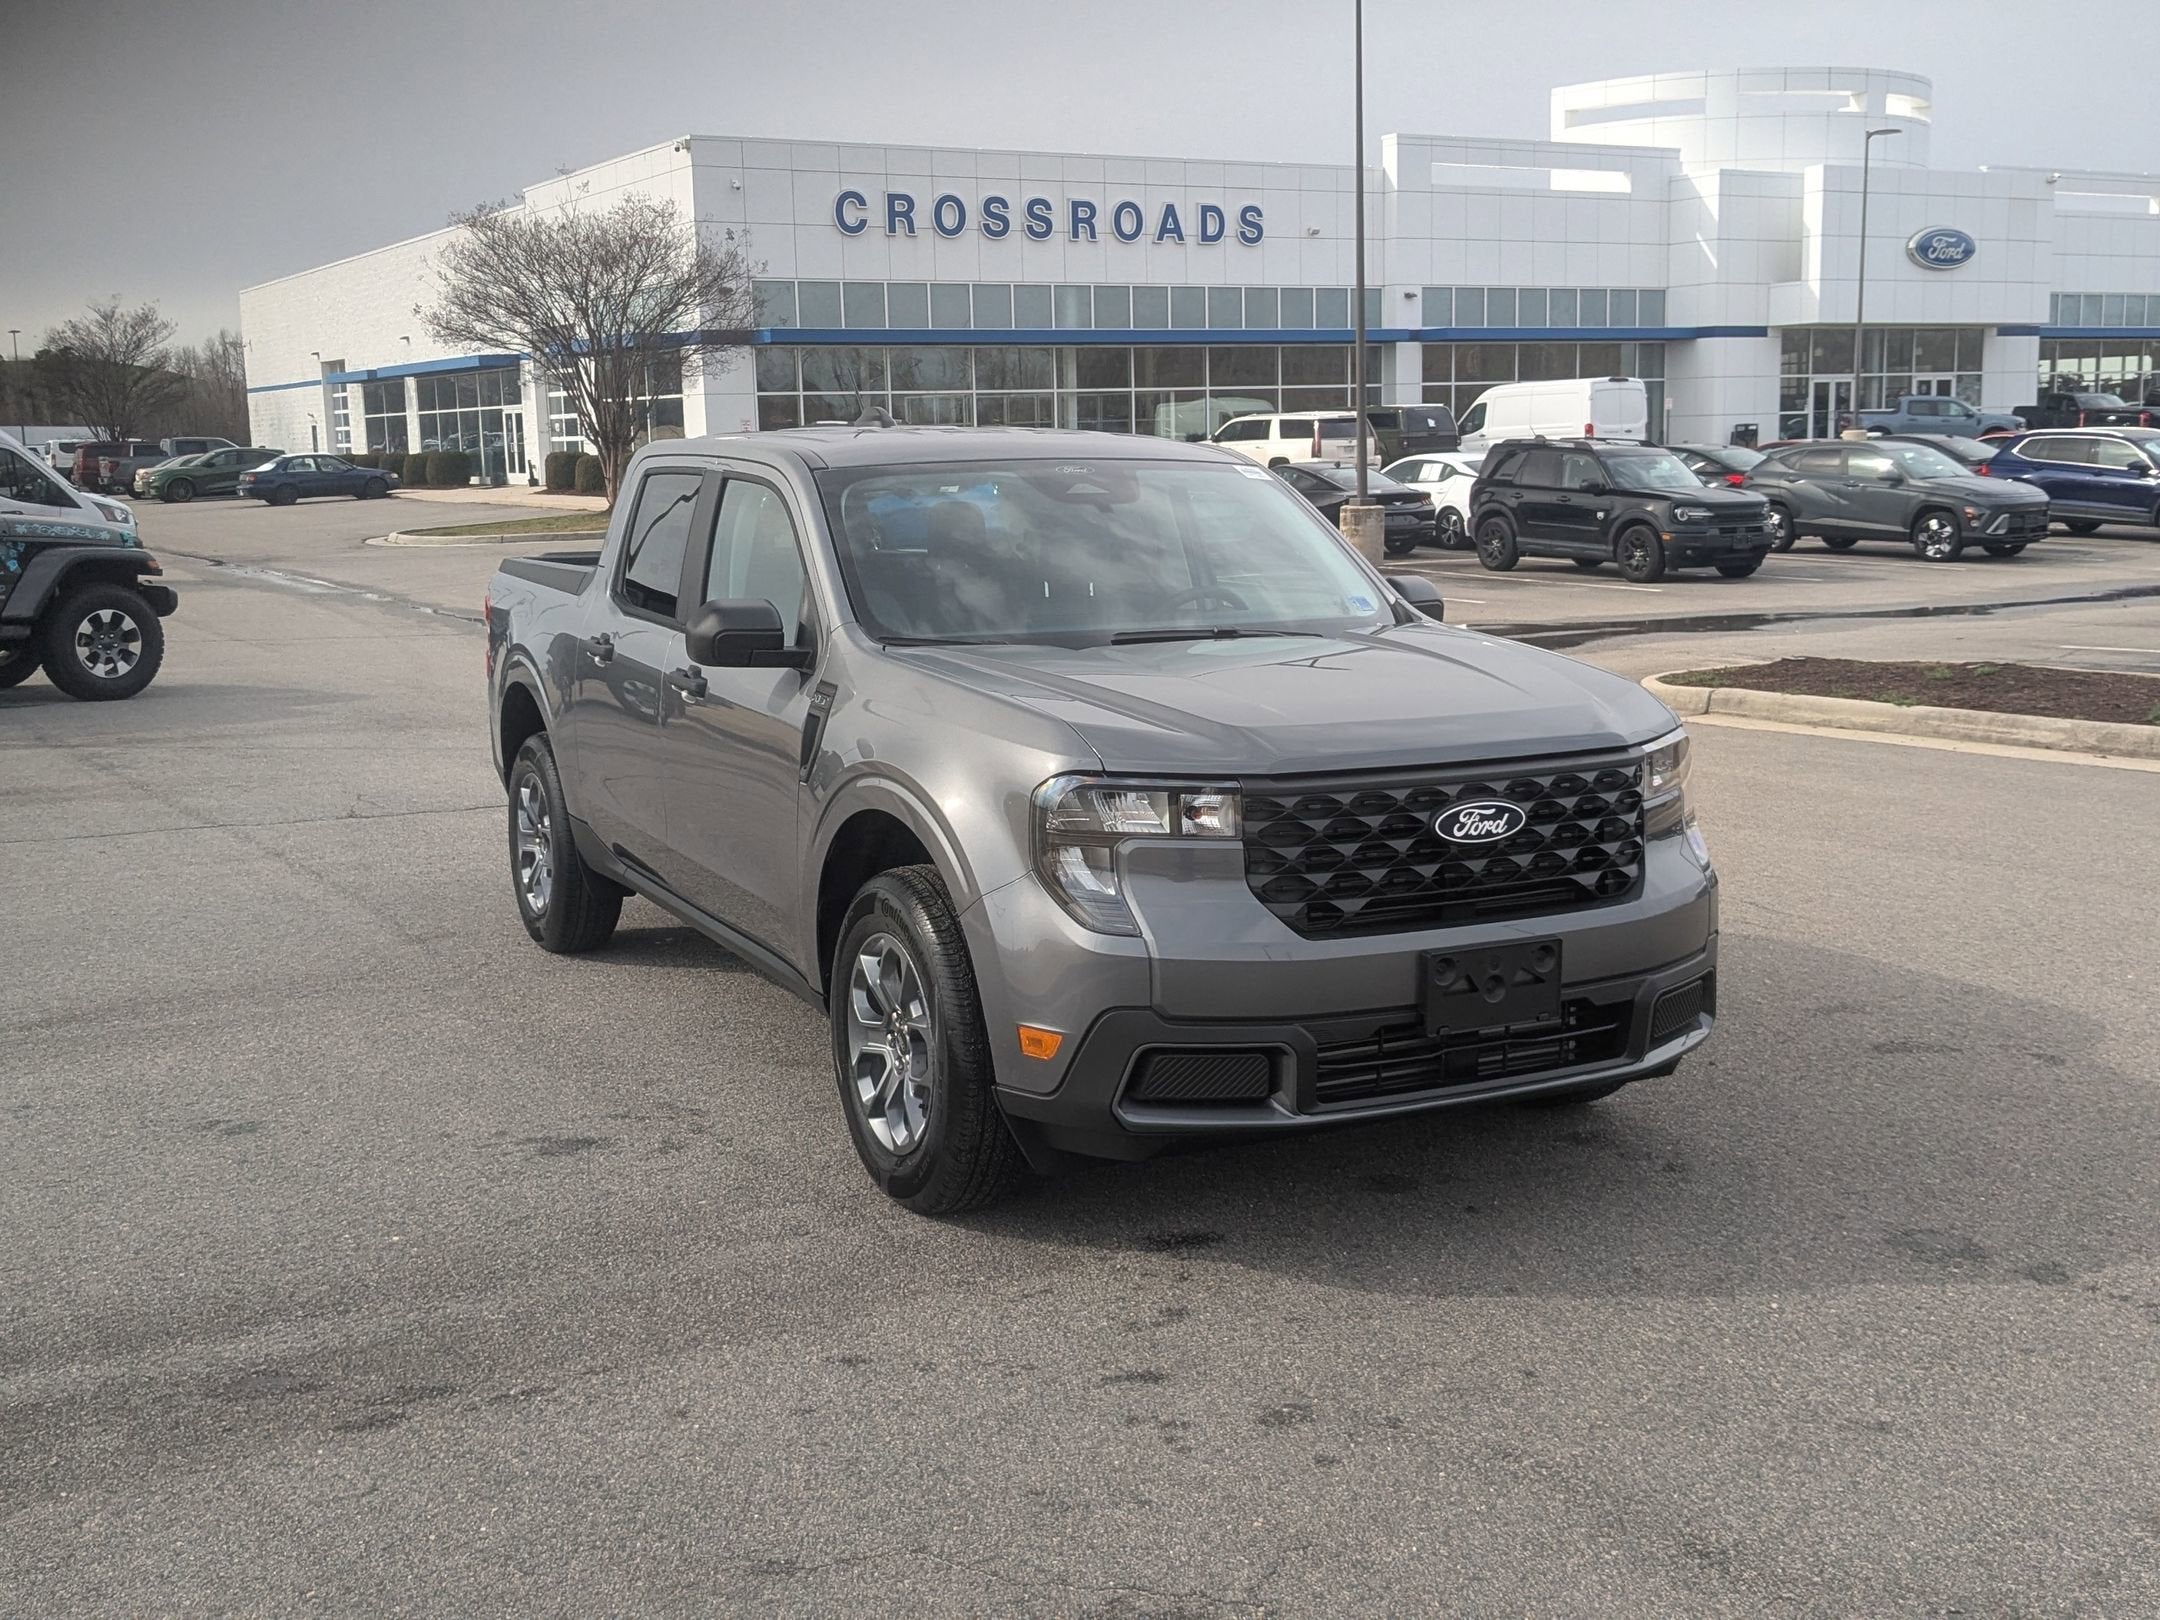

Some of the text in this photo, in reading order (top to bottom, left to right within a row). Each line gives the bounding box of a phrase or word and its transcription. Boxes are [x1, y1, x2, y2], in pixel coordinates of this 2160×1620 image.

[834, 189, 1265, 245] CROSSROADS
[1927, 236, 1966, 259] Ford
[1453, 808, 1509, 837] Ford
